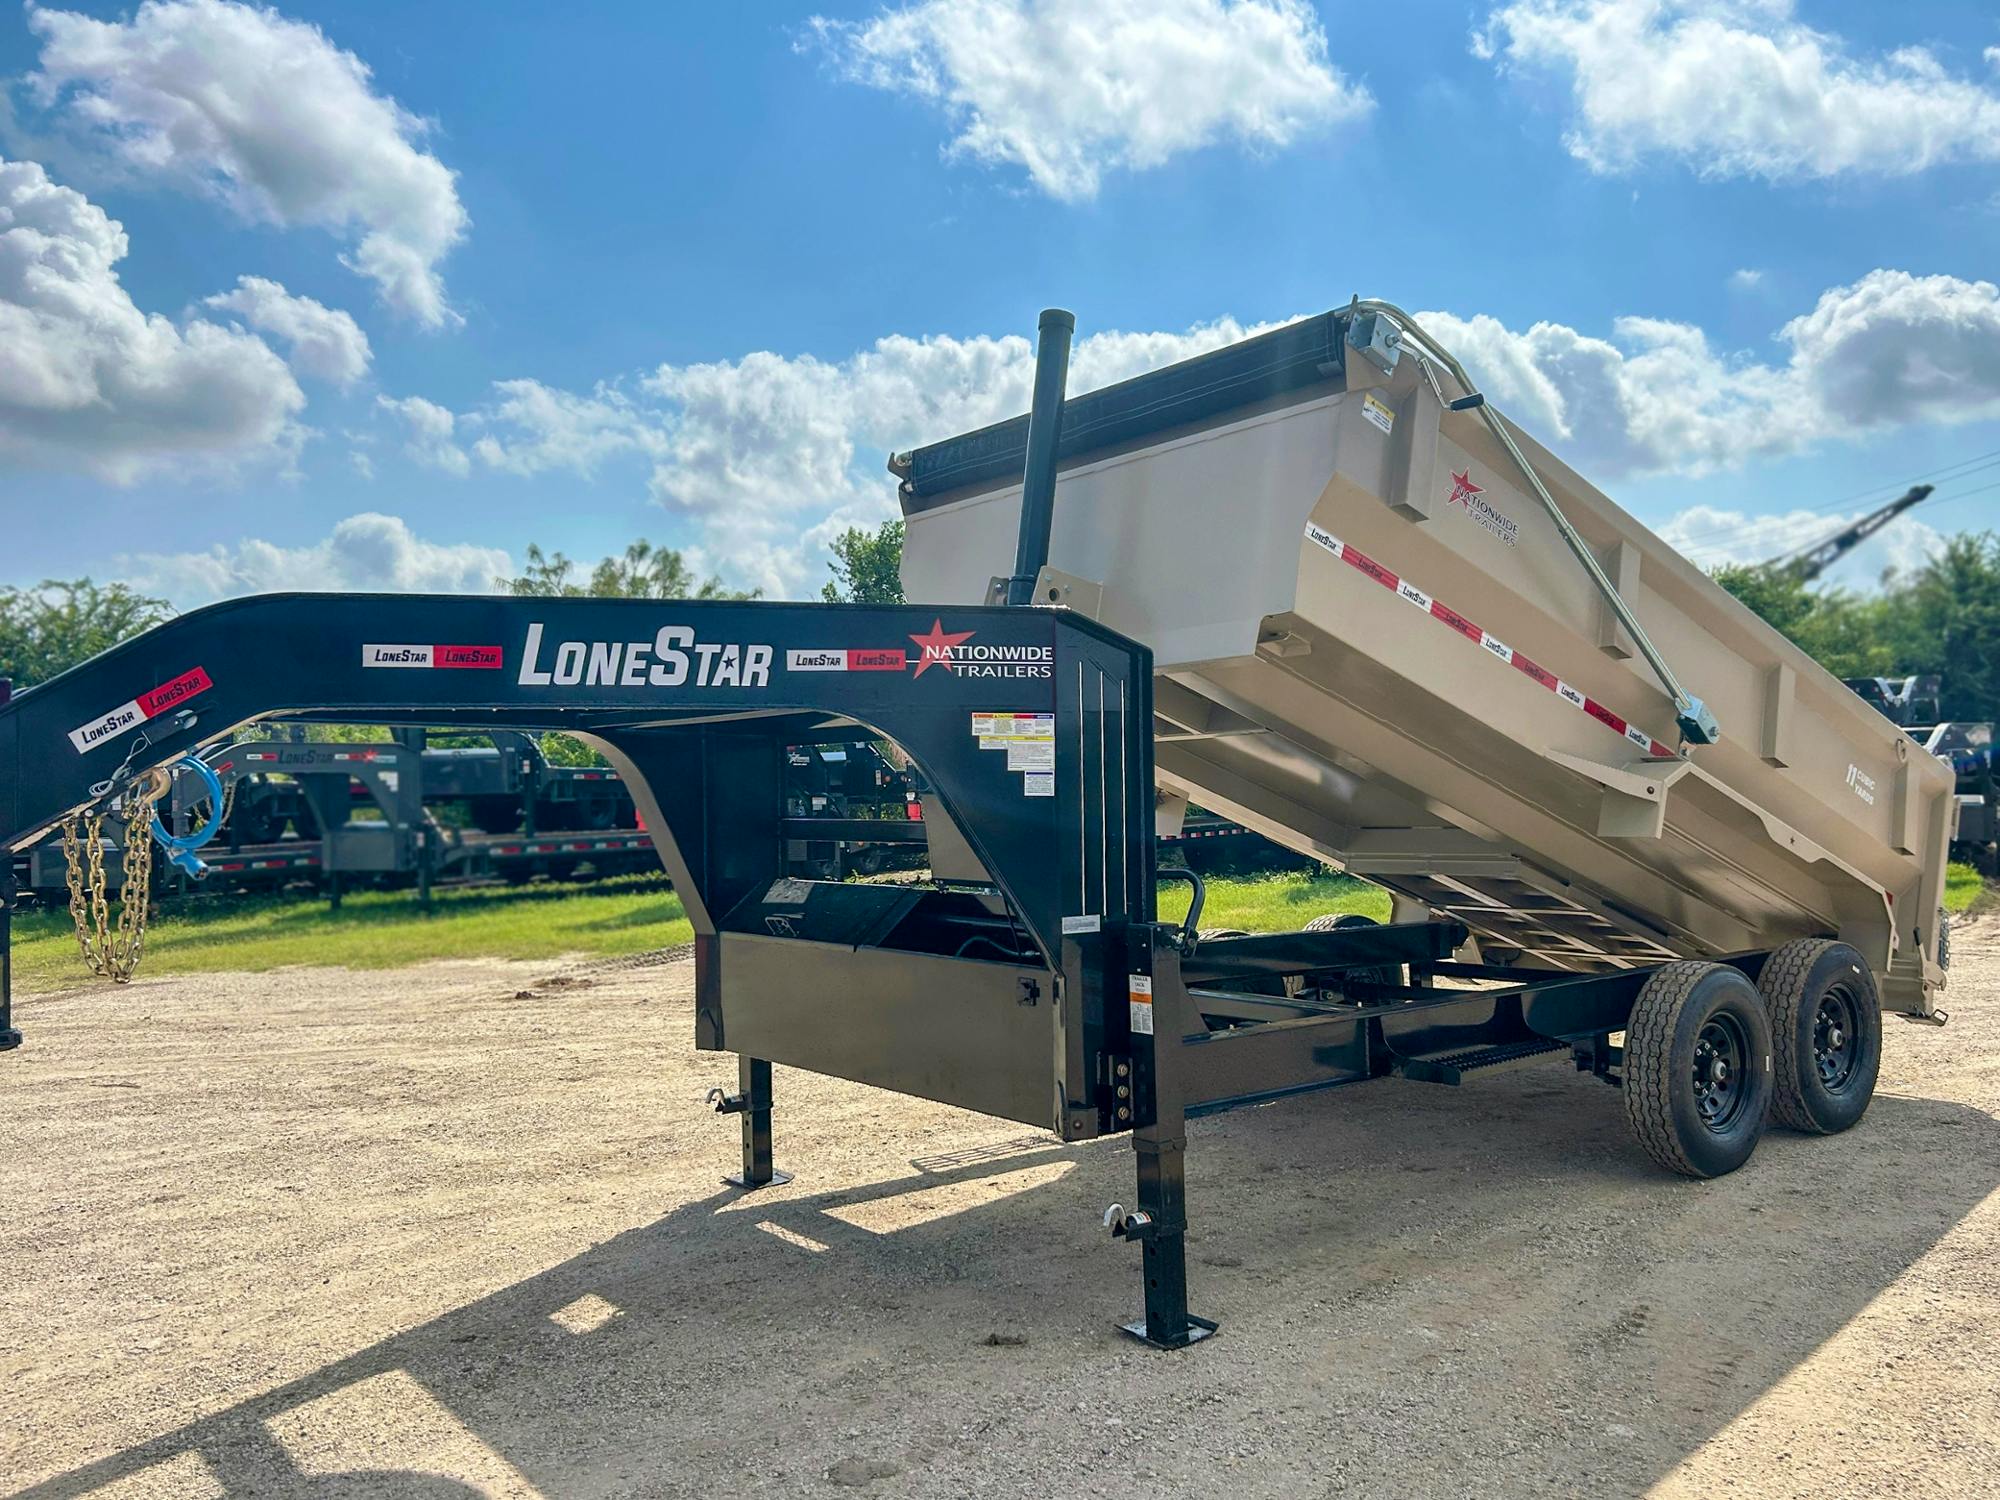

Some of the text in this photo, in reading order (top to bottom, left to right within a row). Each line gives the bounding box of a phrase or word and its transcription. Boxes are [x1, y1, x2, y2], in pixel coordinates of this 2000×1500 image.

[1456, 484, 1519, 535] NATIONWIDE
[1468, 509, 1516, 547] TRAILERS
[925, 645, 1053, 660] NATIONWIDE
[952, 665, 1052, 678] TRAILERS
